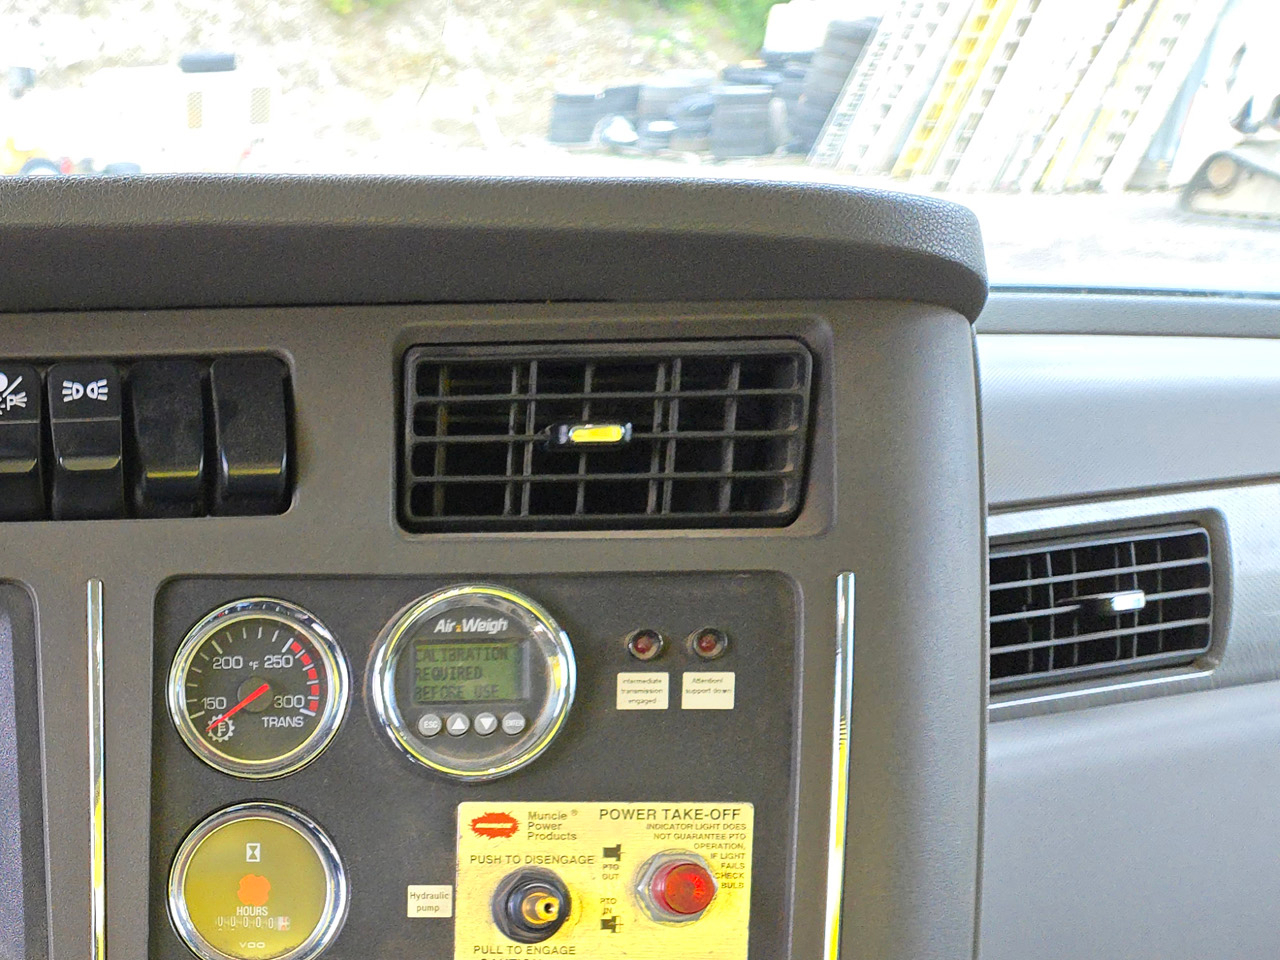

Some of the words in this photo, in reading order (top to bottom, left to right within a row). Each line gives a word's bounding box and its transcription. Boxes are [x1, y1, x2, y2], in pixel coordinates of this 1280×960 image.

[212, 656, 243, 670] 200
[263, 654, 294, 669] 250
[201, 696, 227, 710] 150
[273, 695, 305, 708] 300
[261, 716, 304, 728] TRANS
[423, 721, 438, 729] ESC
[599, 808, 657, 820] POWER
[662, 808, 741, 820] TAKE-OFF
[527, 822, 562, 831] Power
[527, 831, 577, 841] Products
[653, 833, 671, 841] NOT
[470, 855, 502, 865] PUSH
[505, 855, 521, 865] TO
[525, 855, 595, 865] DISENGAGE
[715, 872, 744, 880] CHECK
[409, 891, 450, 901] Hydraulic
[236, 906, 268, 916] HOURS
[416, 903, 440, 913] pump
[473, 945, 504, 955] PULL
[506, 945, 522, 955] TO
[526, 945, 576, 955] ENGAGE
